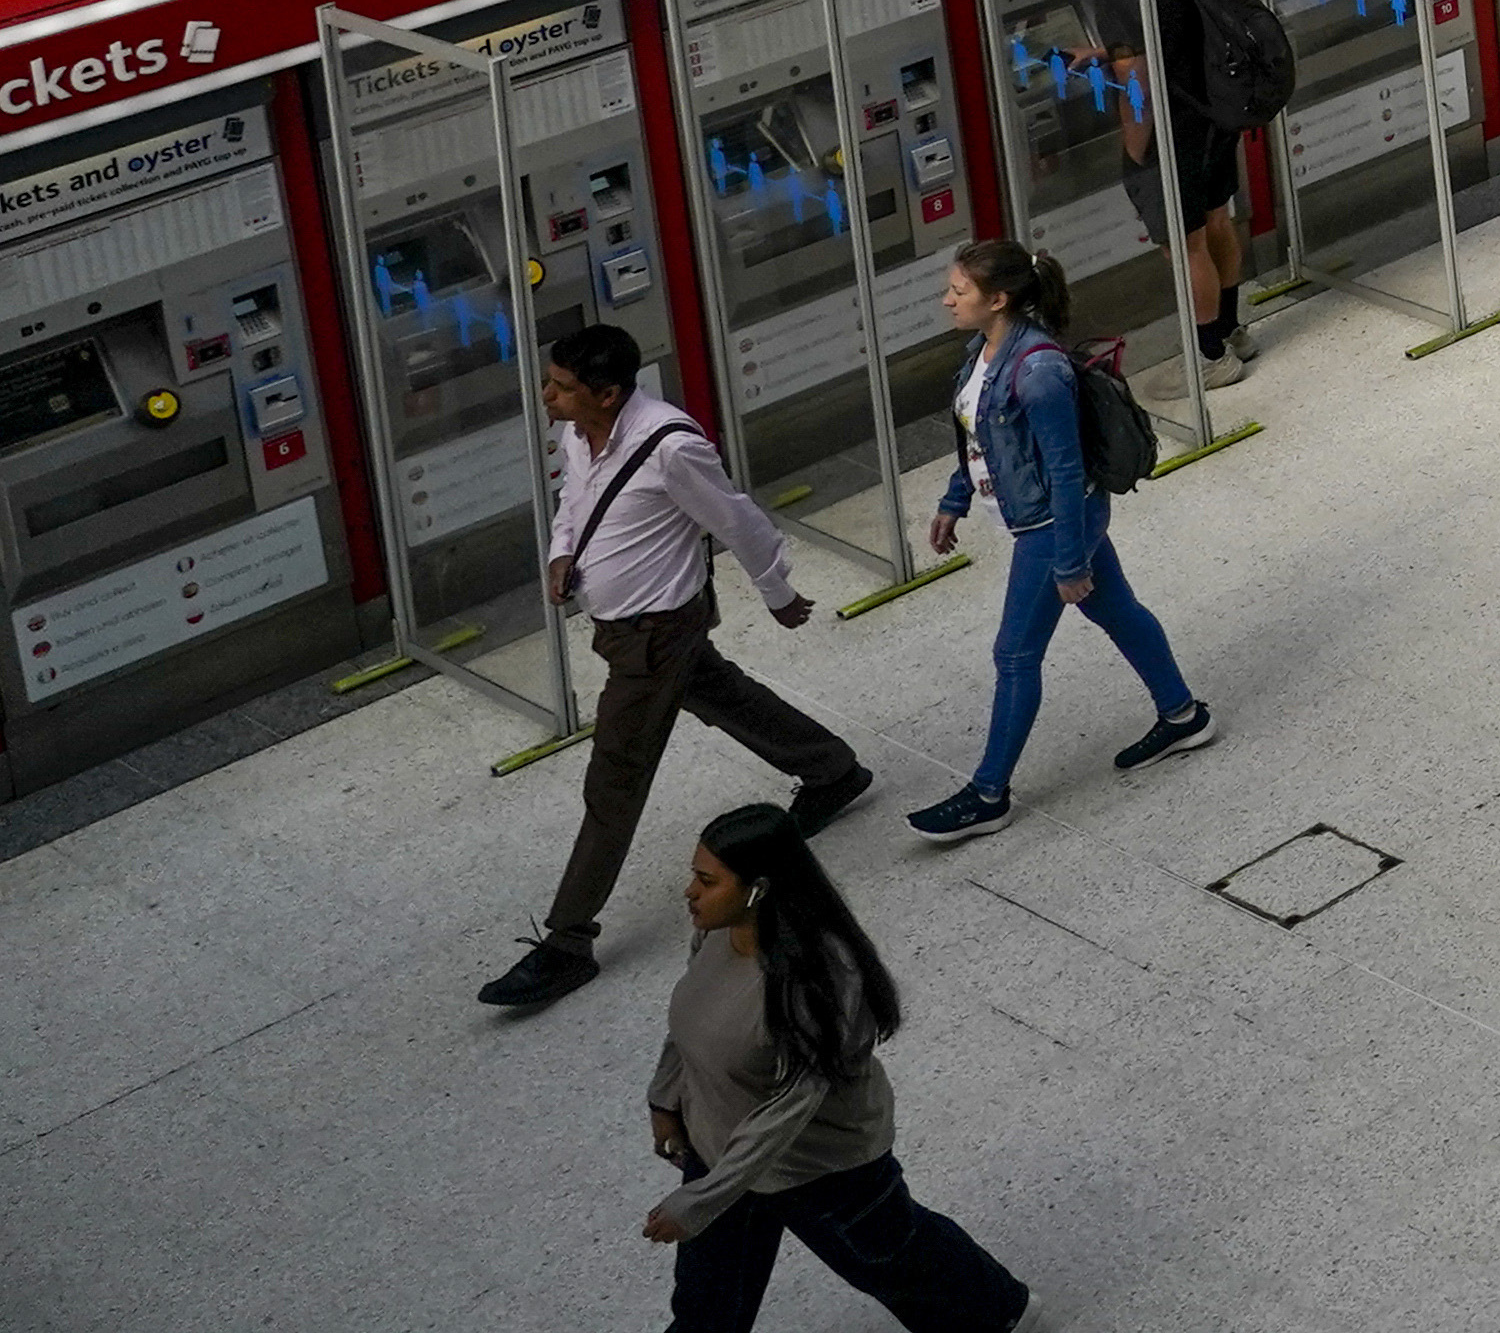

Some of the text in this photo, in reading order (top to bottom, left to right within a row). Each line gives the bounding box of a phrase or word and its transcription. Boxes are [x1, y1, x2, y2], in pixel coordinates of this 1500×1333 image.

[350, 15, 574, 99] Tickets oyster
[70, 132, 213, 192] and oyster
[110, 173, 161, 200] collection
[277, 441, 291, 456] 6
